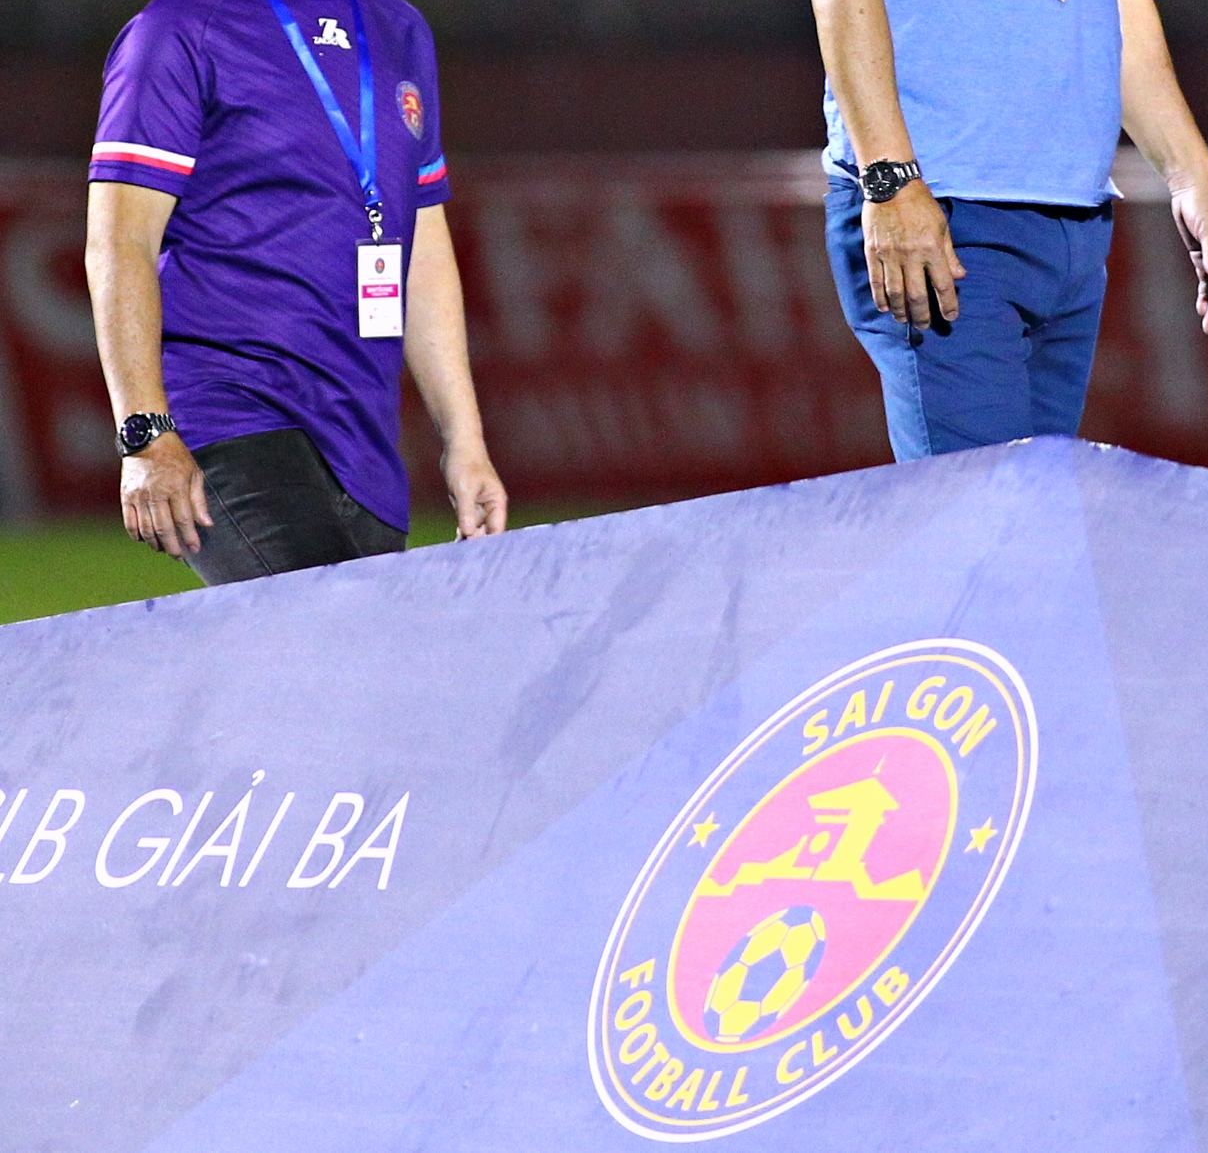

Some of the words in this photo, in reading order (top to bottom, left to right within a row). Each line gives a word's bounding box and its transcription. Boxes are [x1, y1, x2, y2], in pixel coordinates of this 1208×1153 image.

[802, 679, 894, 755] SAI
[905, 675, 998, 757] GON
[94, 769, 295, 888] GIẢI
[286, 791, 410, 890] BA
[614, 959, 749, 1111] FOOTBALL
[776, 965, 911, 1084] CLUB
